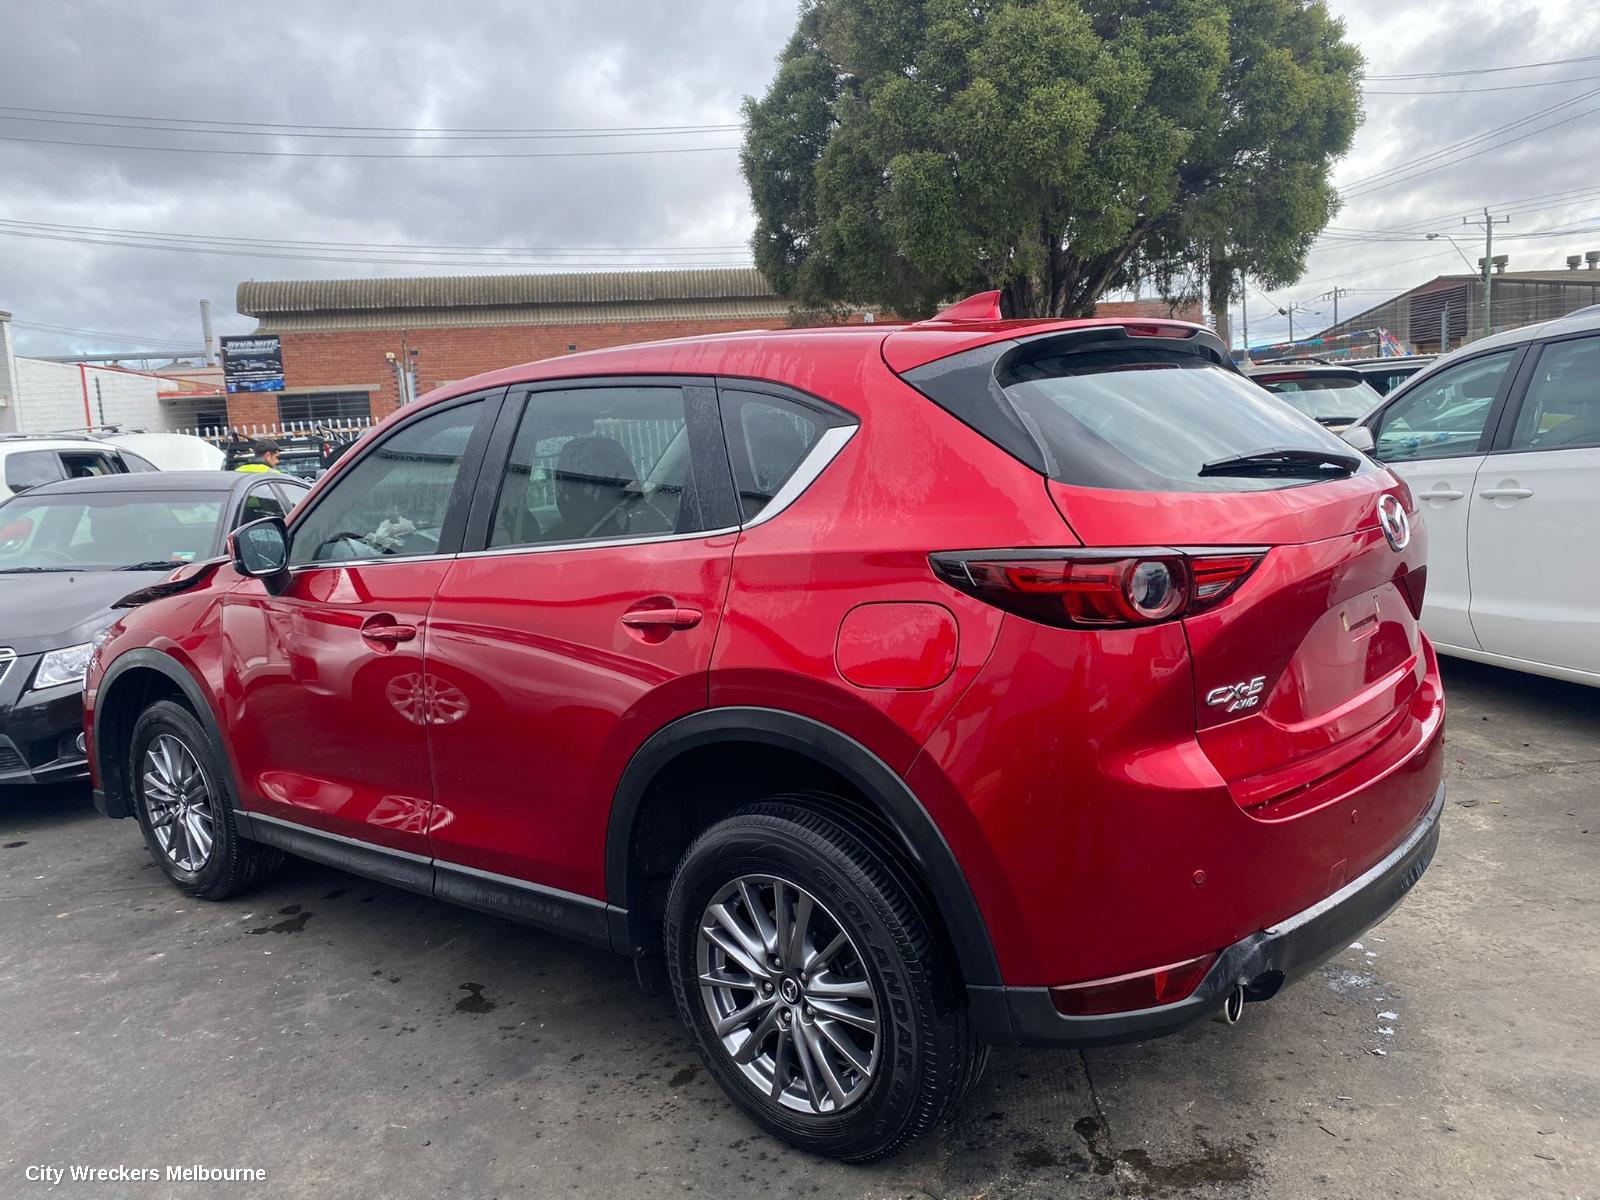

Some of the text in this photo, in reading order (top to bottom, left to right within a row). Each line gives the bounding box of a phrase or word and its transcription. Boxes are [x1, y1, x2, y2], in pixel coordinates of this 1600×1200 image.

[1207, 676, 1266, 705] CX-5
[1227, 696, 1259, 712] AWD
[813, 866, 913, 1073] GEOLANDAR
